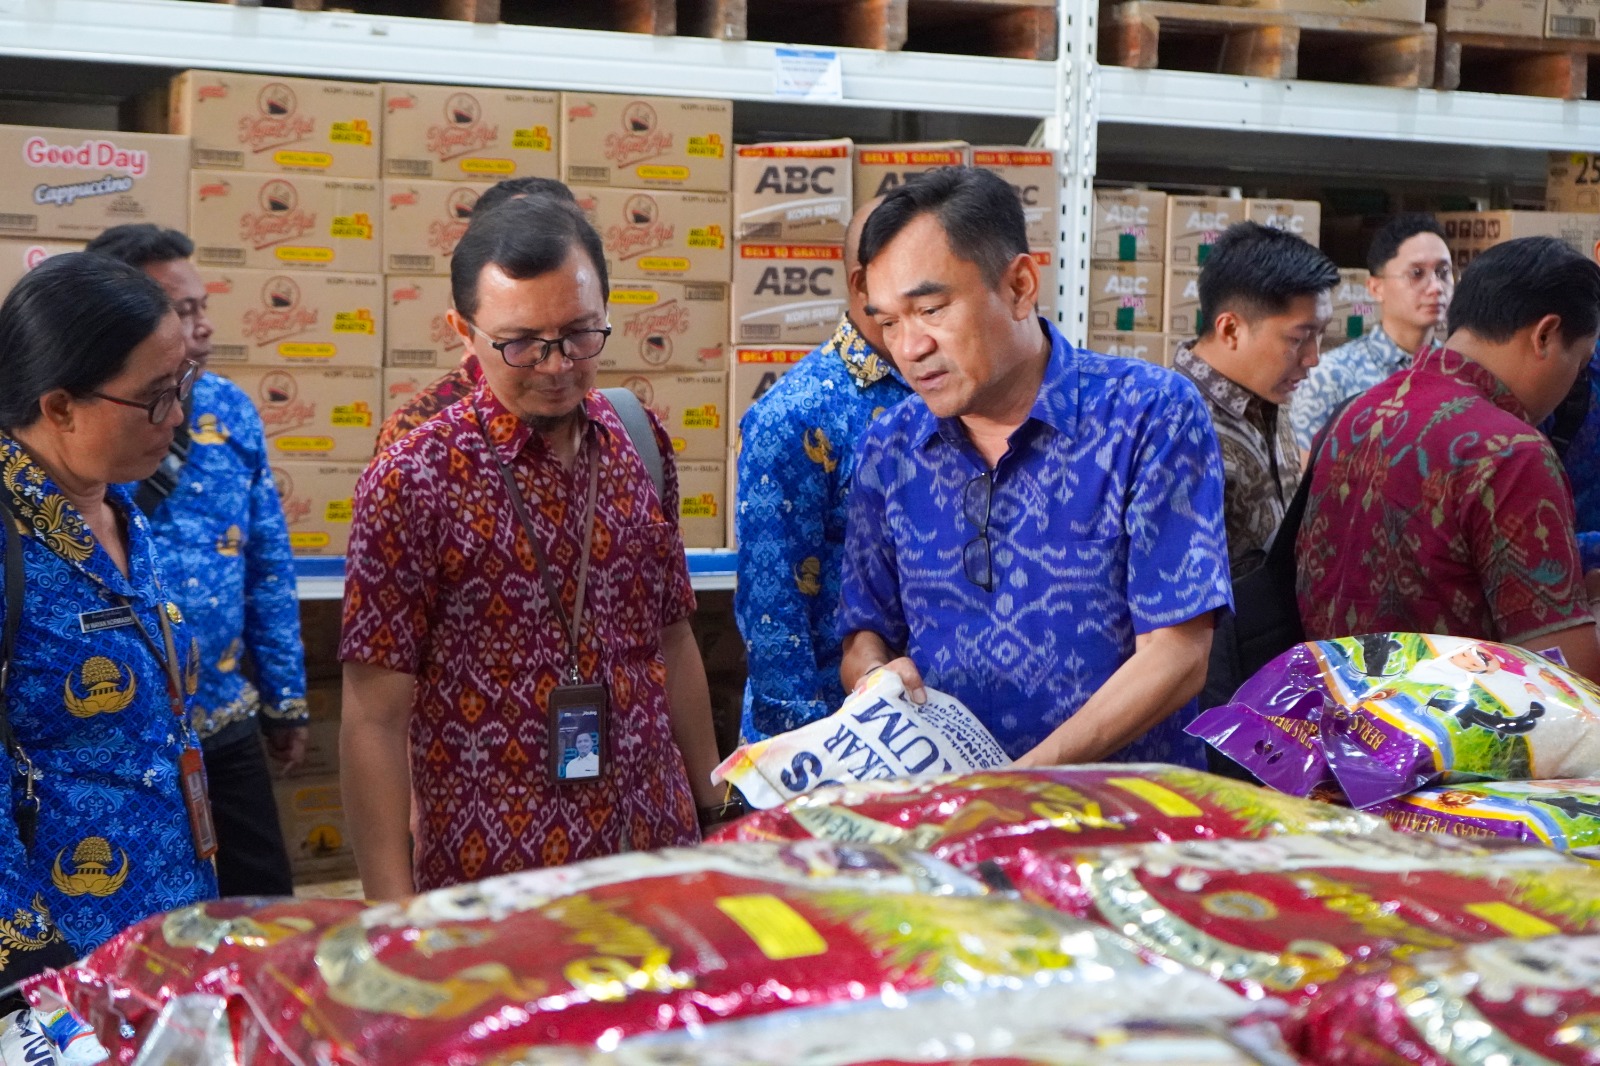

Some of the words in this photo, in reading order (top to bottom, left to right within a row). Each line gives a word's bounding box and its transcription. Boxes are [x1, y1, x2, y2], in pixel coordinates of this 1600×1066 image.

[27, 140, 91, 165] Good
[99, 144, 146, 175] Day
[35, 175, 133, 205] Cappuccino
[755, 165, 836, 195] ABC
[1105, 204, 1149, 224] ABC
[1186, 211, 1229, 230] ABC
[744, 246, 770, 257] BELI
[774, 246, 788, 257] 10
[793, 247, 832, 257] GRATIS
[754, 266, 834, 296] ABC
[1104, 274, 1149, 295] ABC
[773, 352, 787, 362] 10
[684, 418, 713, 426] GRATIS
[851, 697, 953, 776] UM
[942, 724, 991, 769] SINAR
[1349, 714, 1388, 751] BERAS
